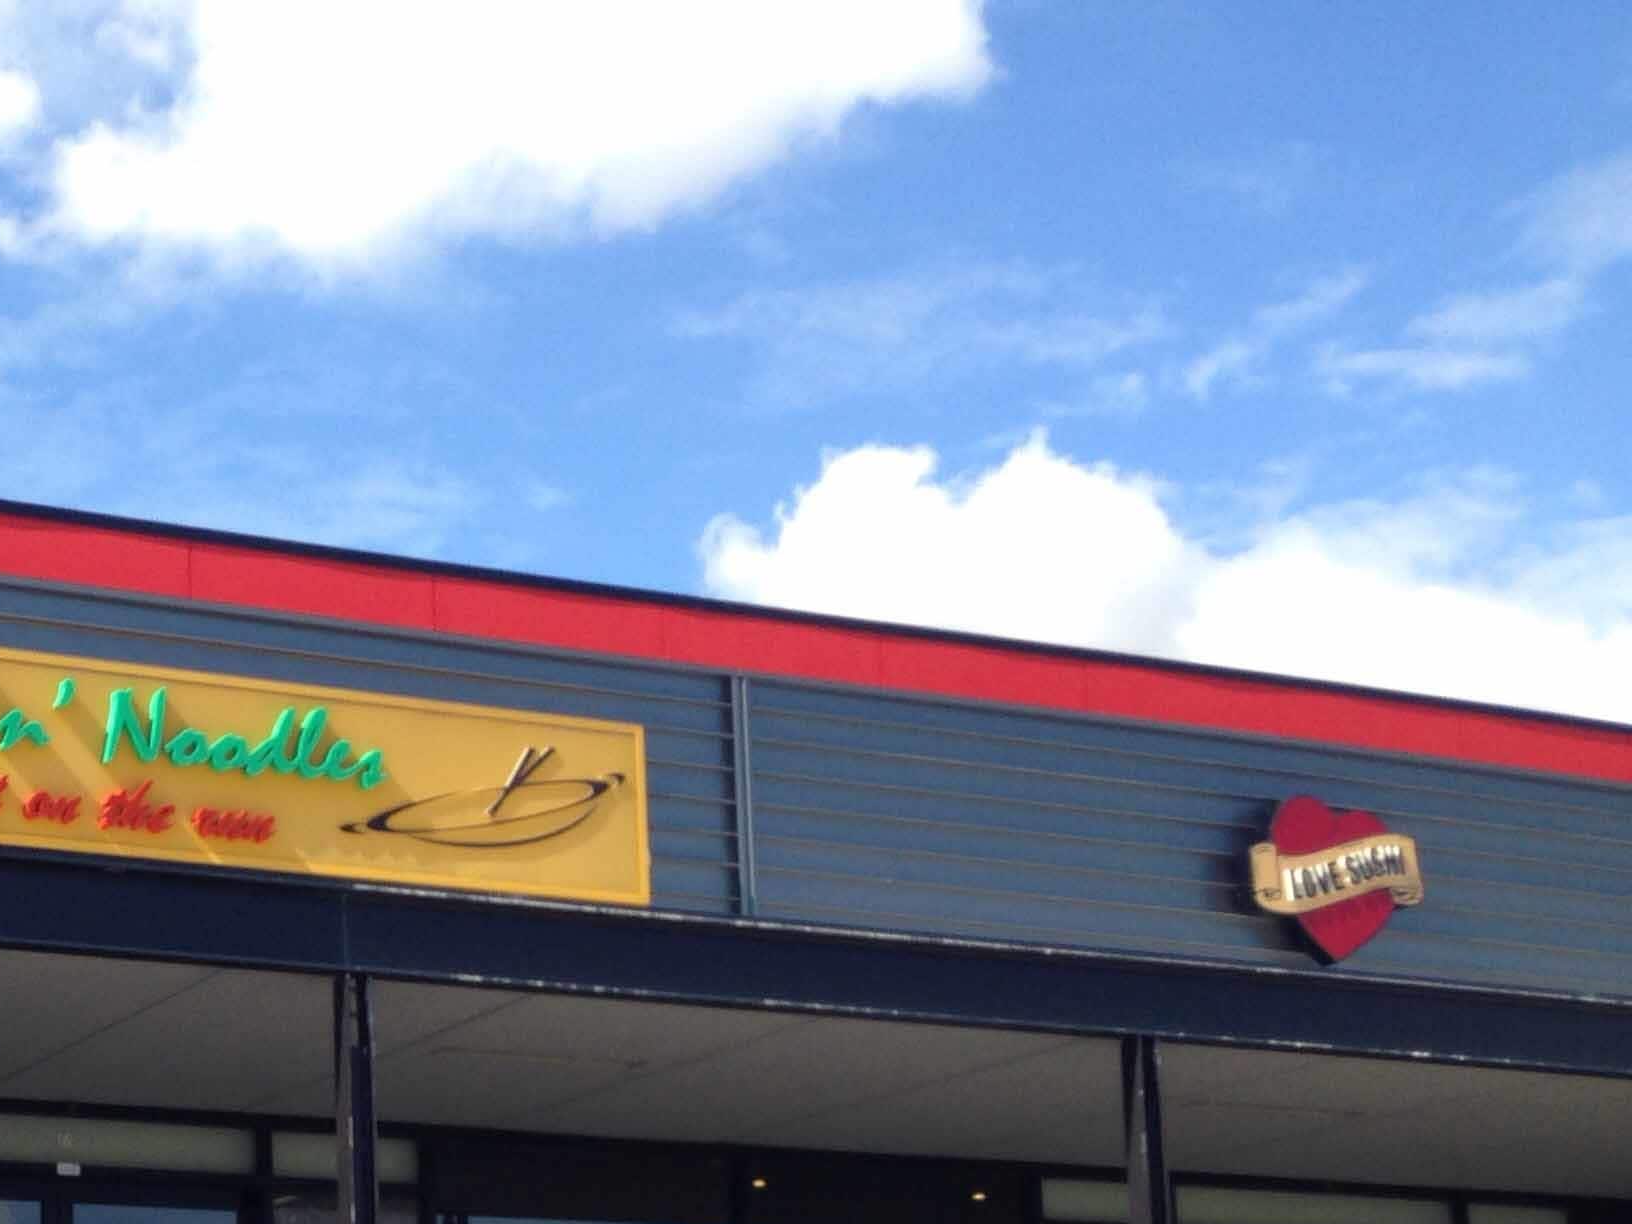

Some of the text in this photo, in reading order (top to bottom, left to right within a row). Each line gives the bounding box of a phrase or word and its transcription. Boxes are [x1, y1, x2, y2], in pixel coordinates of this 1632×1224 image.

[100, 687, 387, 790] Noodles
[22, 790, 81, 824] on
[97, 779, 175, 833] the
[191, 807, 276, 843] run
[1282, 845, 1406, 901] LOVE SUSHI
